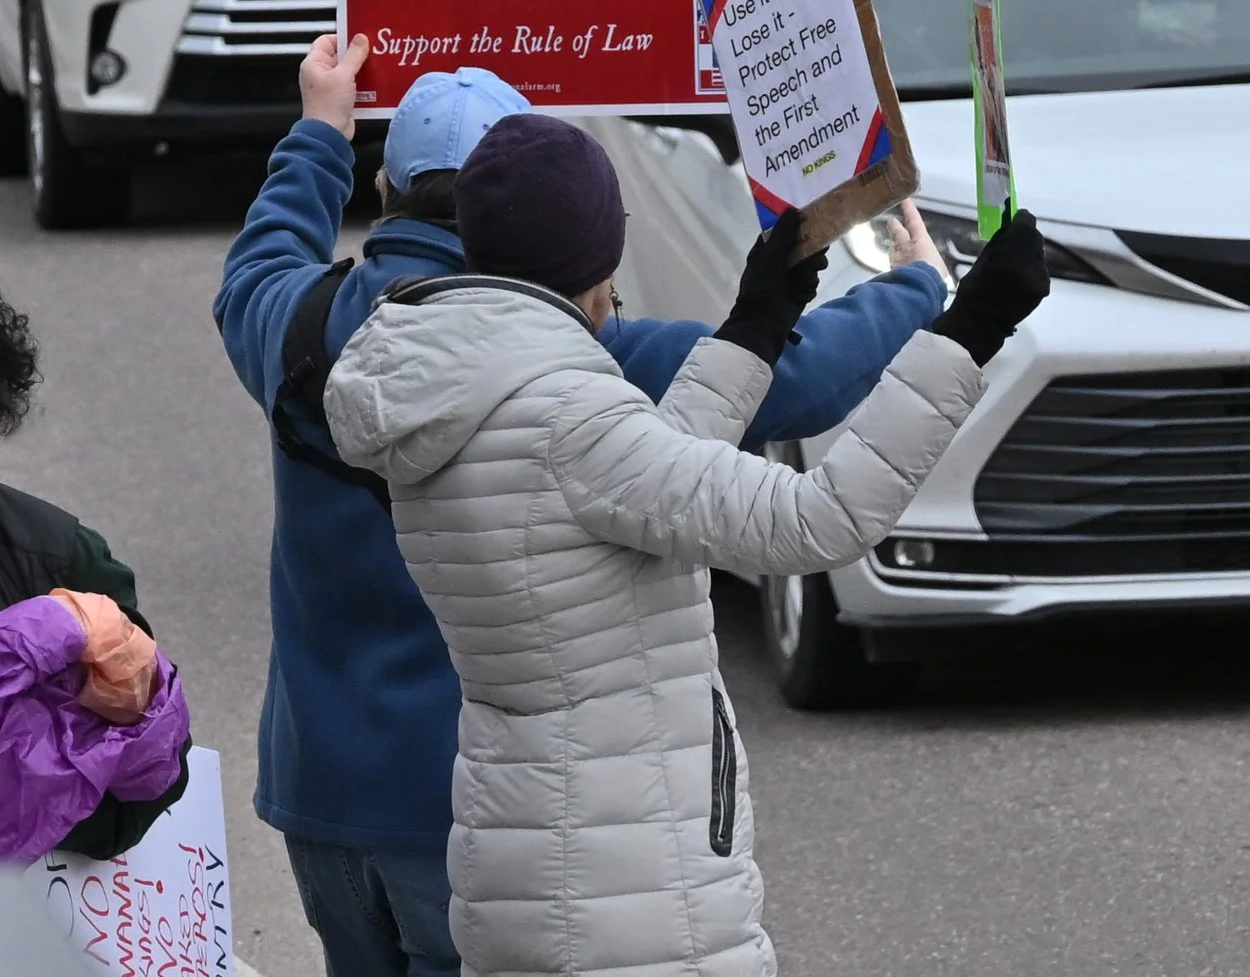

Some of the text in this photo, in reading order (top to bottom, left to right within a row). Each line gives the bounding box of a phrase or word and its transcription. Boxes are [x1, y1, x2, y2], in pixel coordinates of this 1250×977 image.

[723, 0, 756, 27] Use
[731, 25, 770, 57] Lose
[772, 11, 784, 32] it
[372, 24, 653, 66] Support the Rule of Law
[738, 18, 837, 87] Protect Free
[747, 44, 842, 116] Speech and
[755, 94, 820, 147] the First
[766, 104, 860, 177] Amendment
[802, 150, 837, 176] NO KINGS
[79, 875, 110, 966] NO
[205, 844, 228, 977] NTRY
